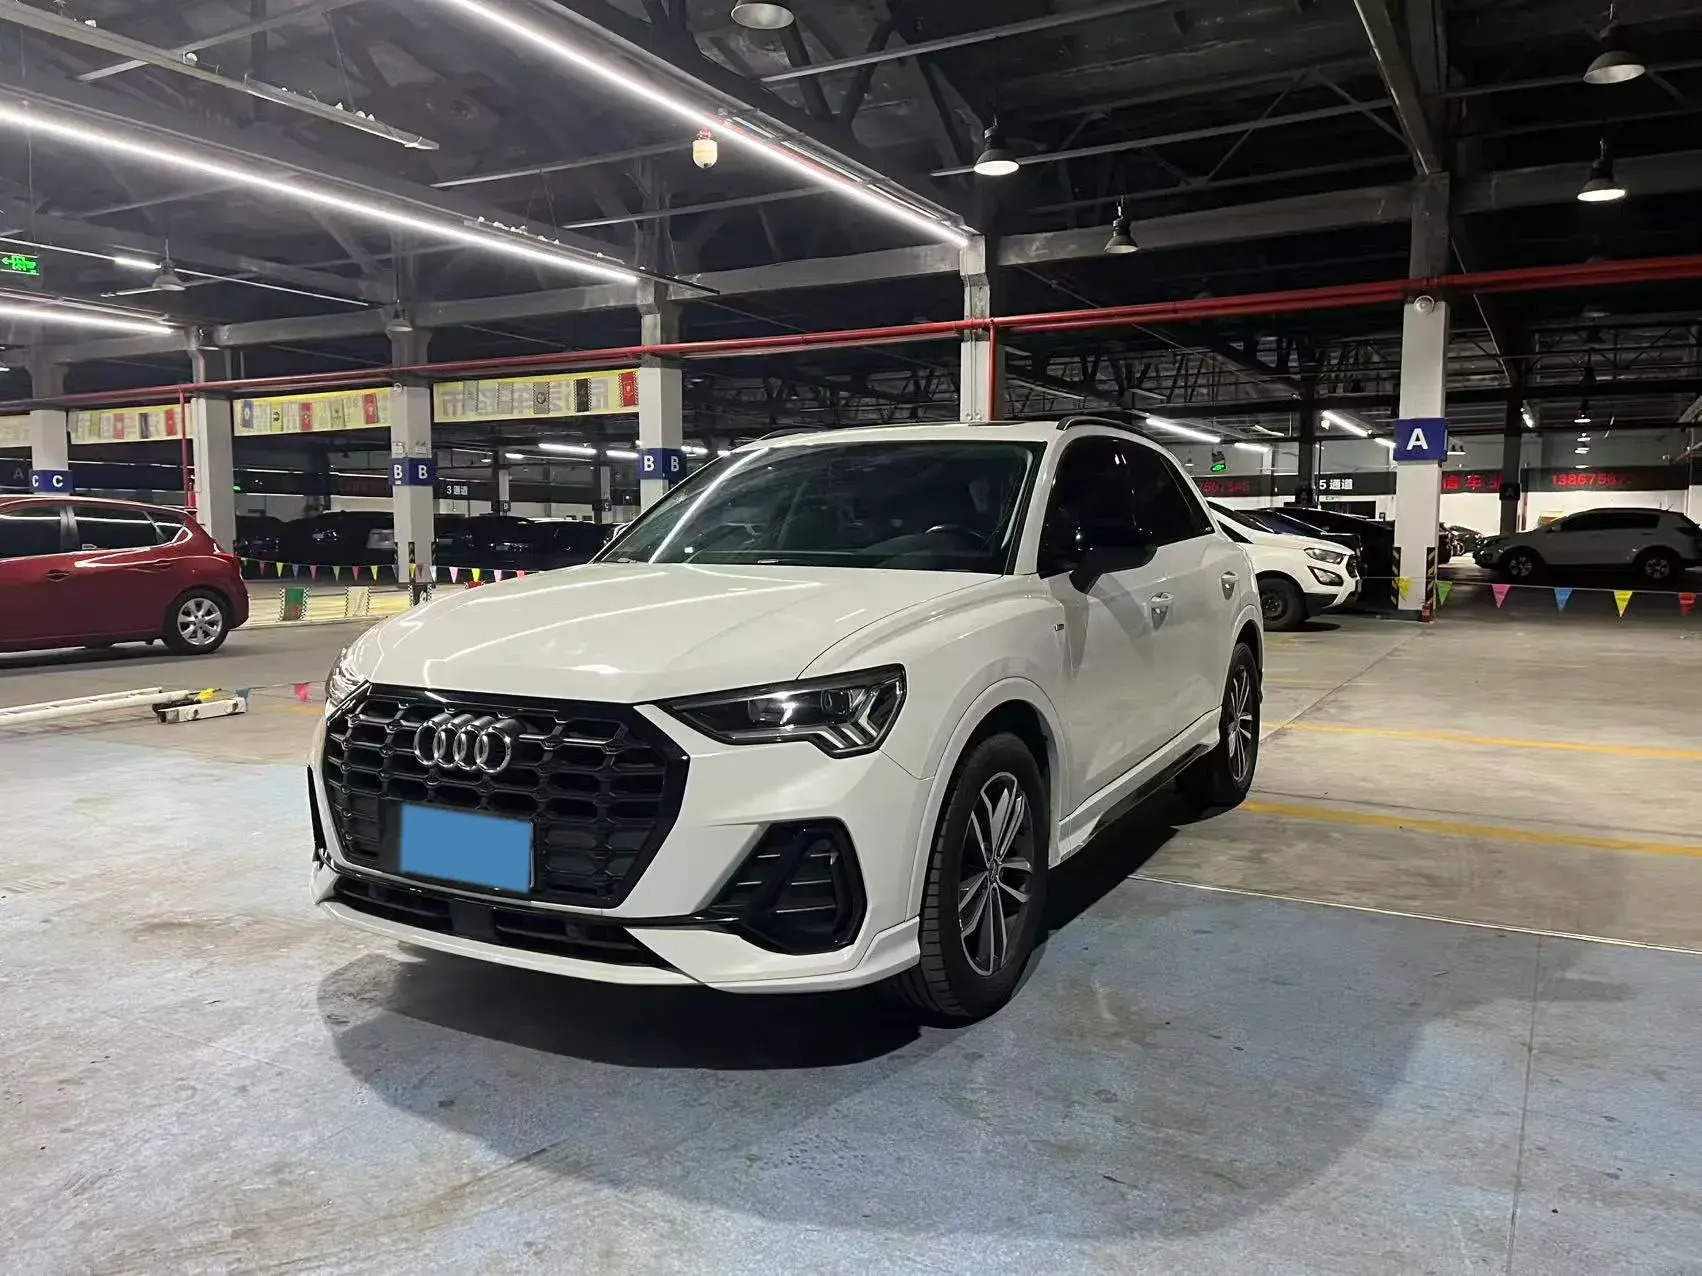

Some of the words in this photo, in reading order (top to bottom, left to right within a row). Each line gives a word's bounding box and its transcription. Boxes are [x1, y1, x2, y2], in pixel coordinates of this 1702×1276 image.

[1406, 428, 1429, 450] A
[644, 455, 654, 472] B
[670, 455, 680, 472] B
[13, 468, 25, 480] A
[393, 464, 403, 479] B
[418, 465, 428, 479] B
[32, 474, 40, 488] C
[52, 474, 64, 488] C
[1319, 479, 1327, 490] 5
[446, 485, 452, 495] 3
